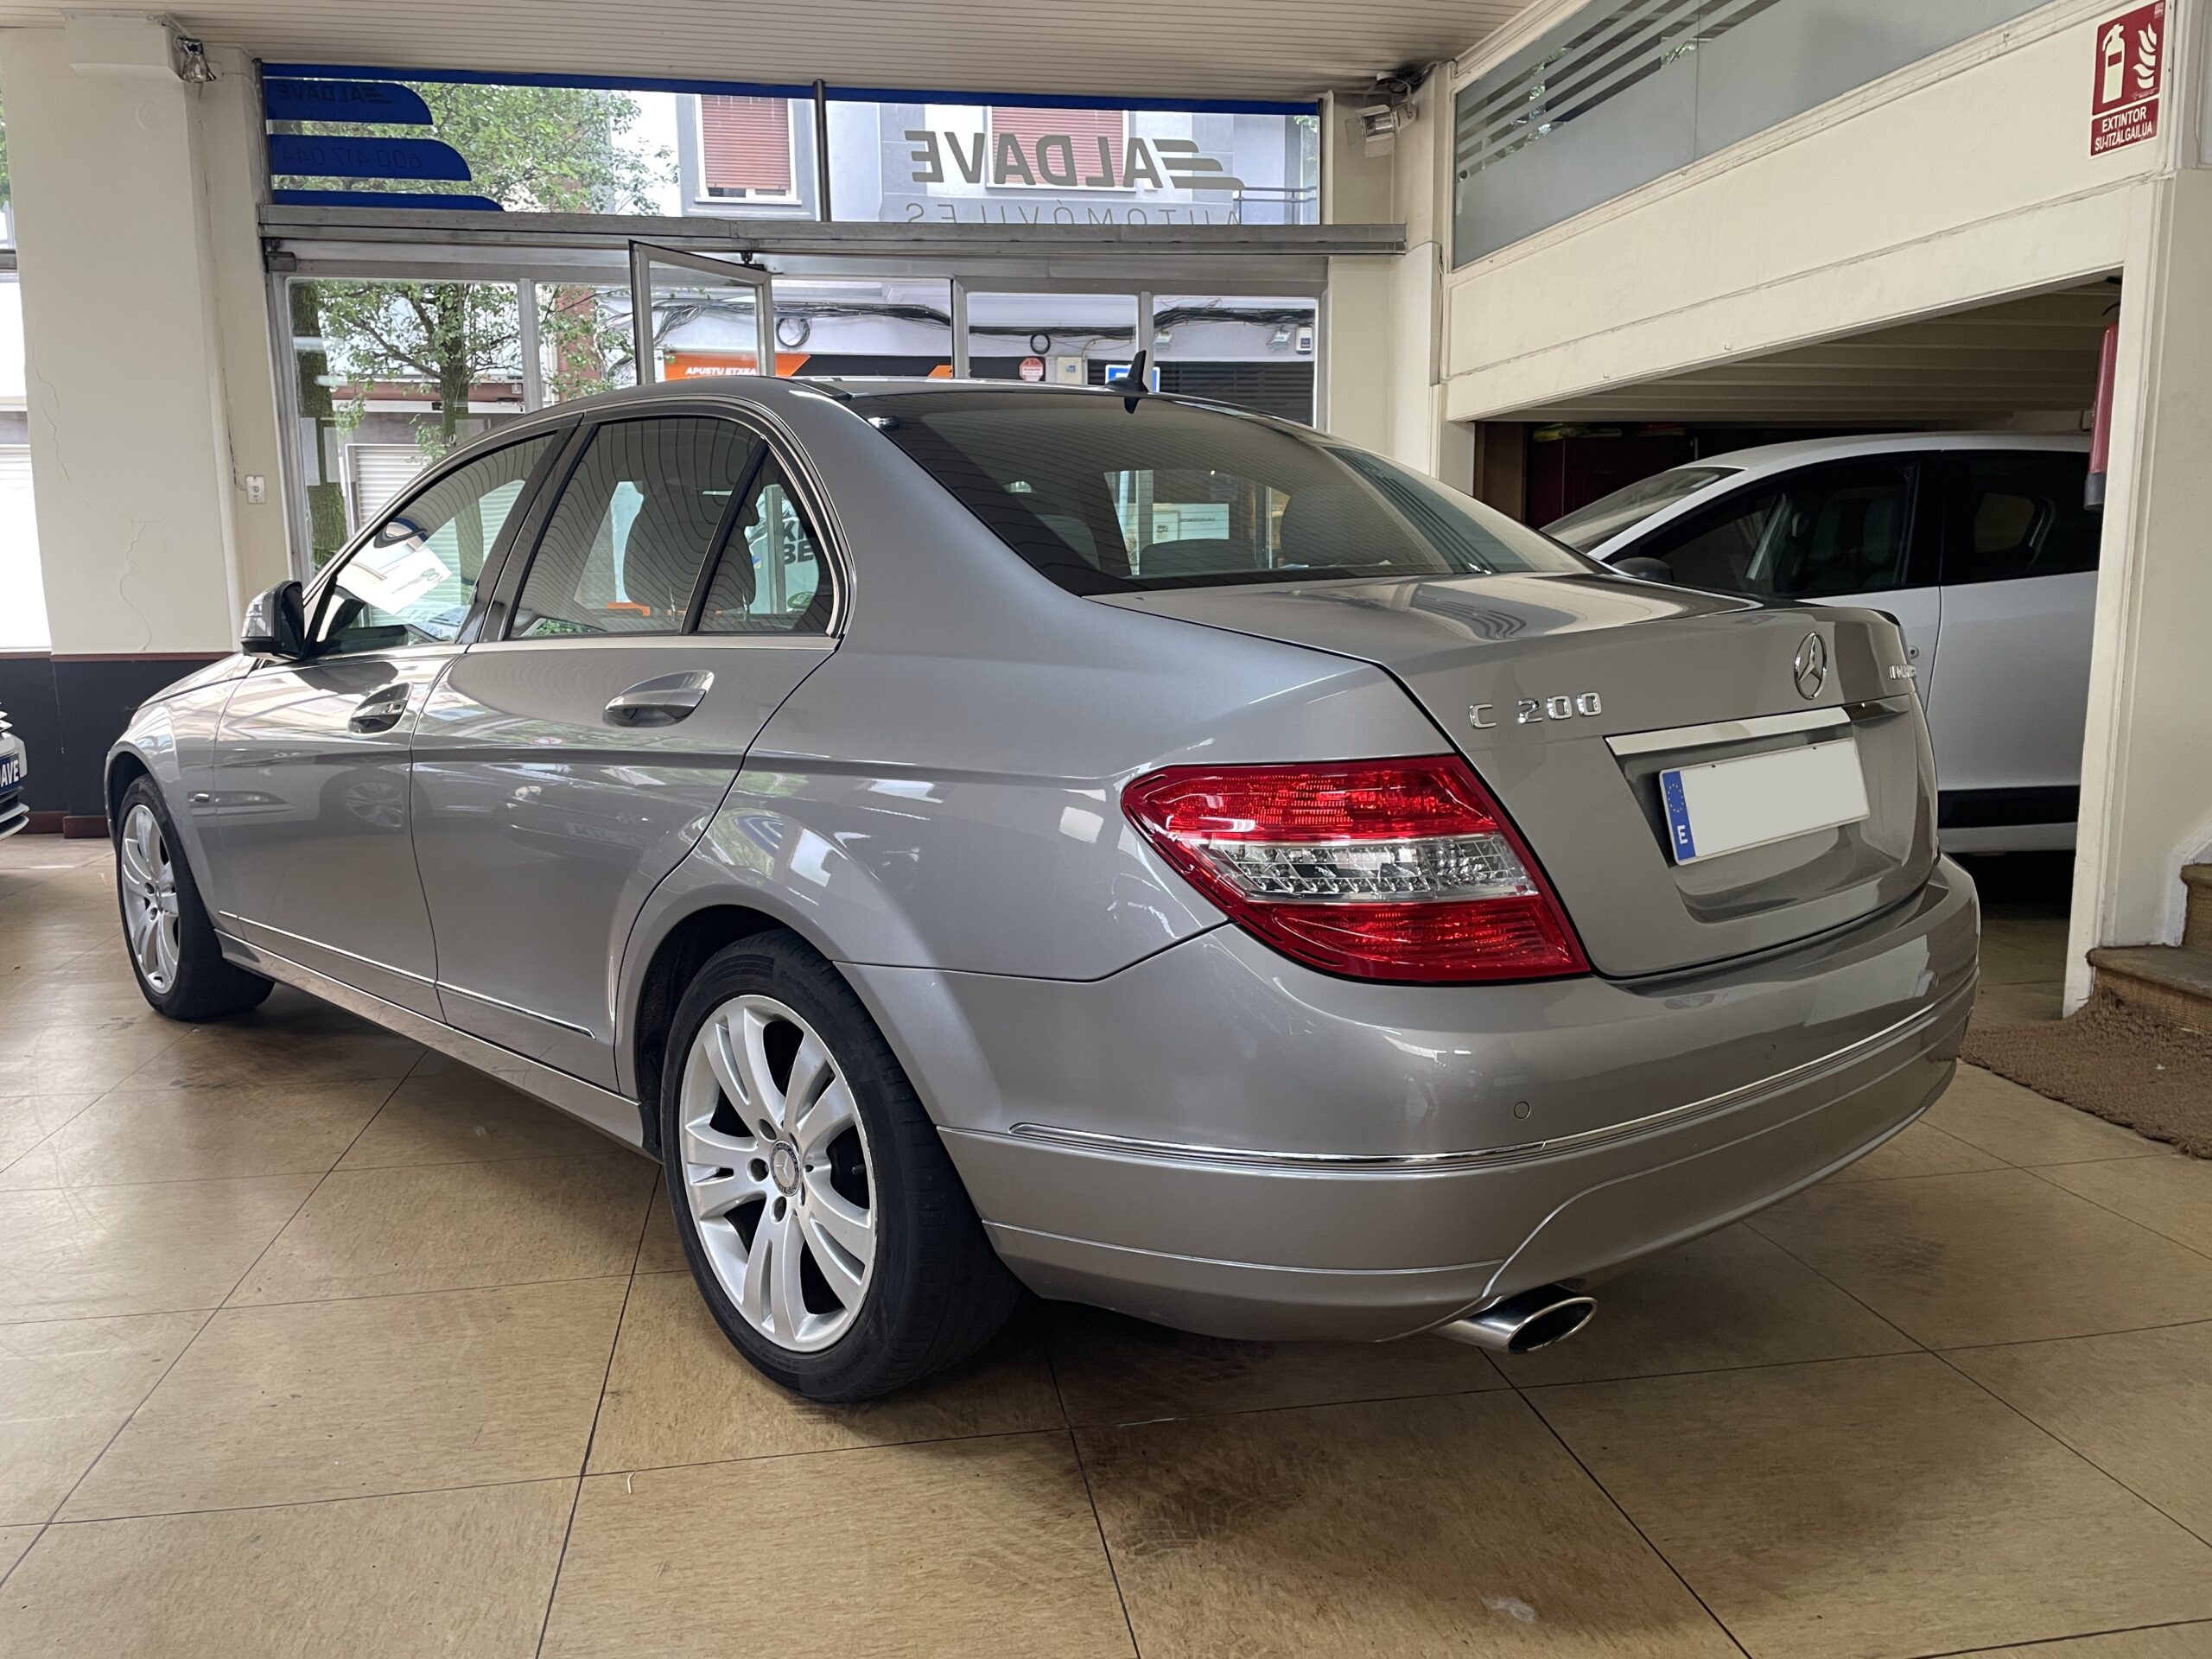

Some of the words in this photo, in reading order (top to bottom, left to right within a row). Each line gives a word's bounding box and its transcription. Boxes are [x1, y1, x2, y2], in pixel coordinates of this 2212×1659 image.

[2101, 105, 2147, 133] EXTINTOR
[2094, 120, 2153, 152] SU-ITZALGAILUA
[685, 366, 725, 375] APUSTU
[725, 367, 757, 376] ETXEA
[1469, 703, 1497, 728] C
[1517, 692, 1602, 725] 200
[0, 760, 19, 787] AVE
[1677, 825, 1688, 844] E
